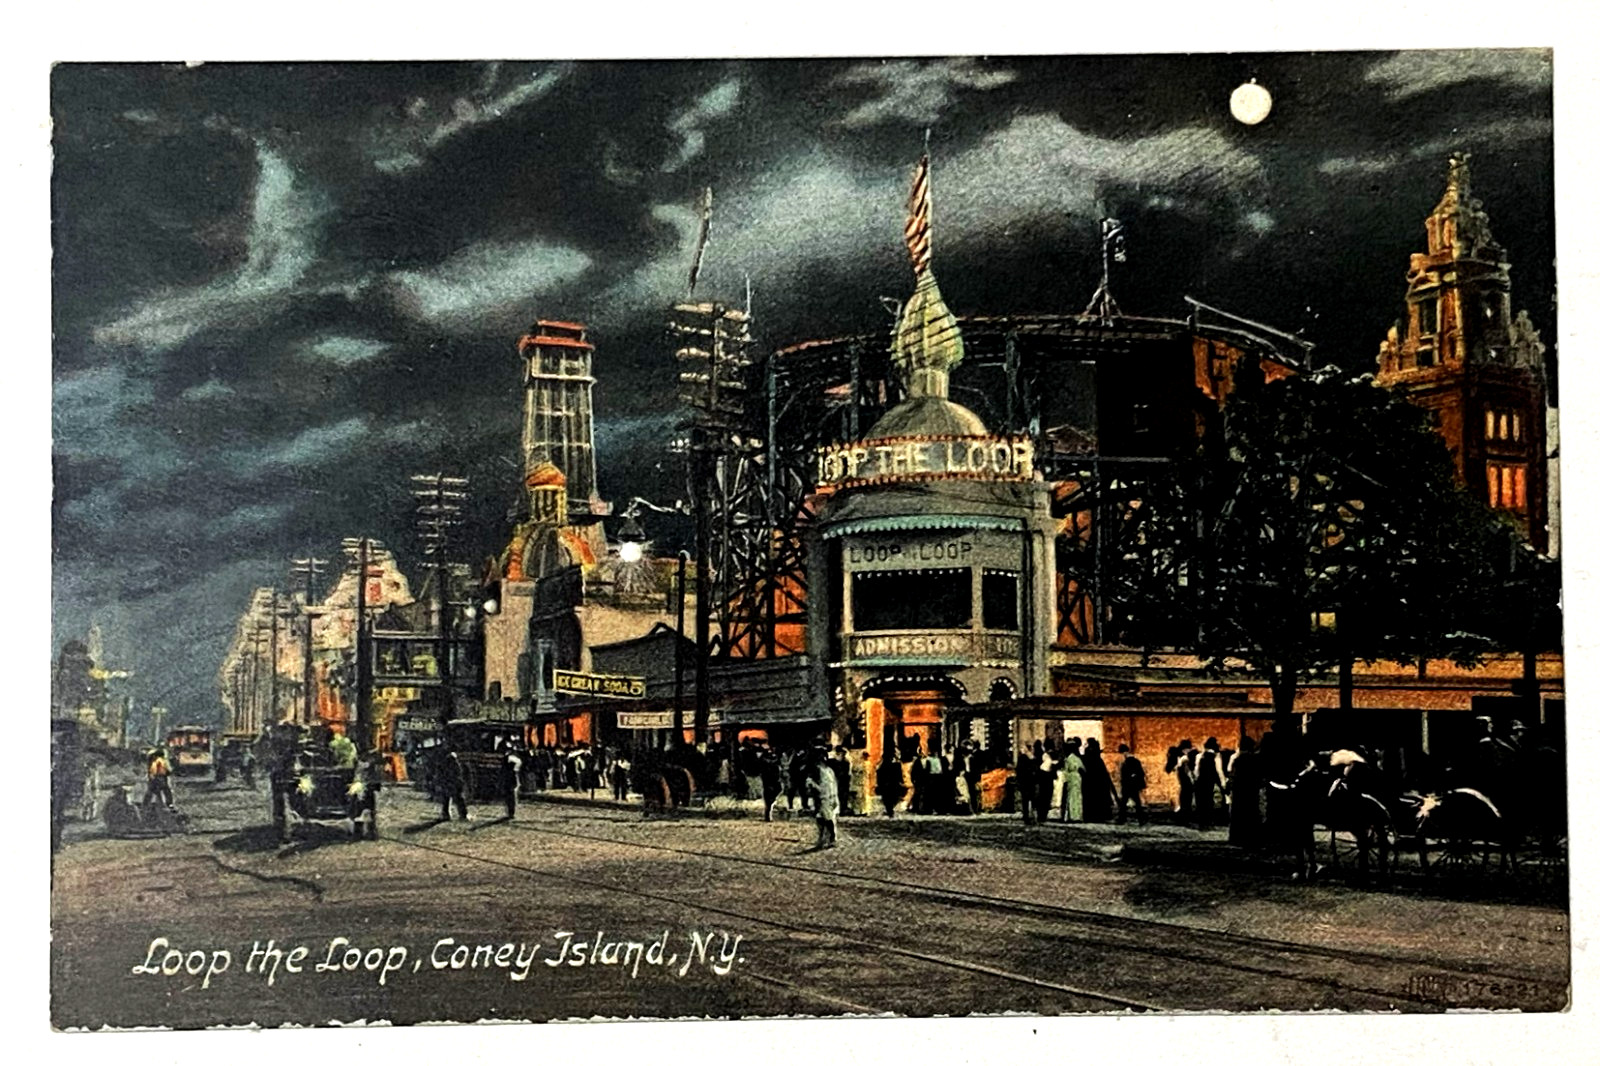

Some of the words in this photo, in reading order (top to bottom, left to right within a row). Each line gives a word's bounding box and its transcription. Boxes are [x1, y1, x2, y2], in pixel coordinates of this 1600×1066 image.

[875, 442, 931, 475] THE
[947, 438, 1034, 479] LOOP
[850, 544, 901, 563] LOOP
[921, 542, 972, 560] LOOP
[132, 937, 231, 989] Loop
[245, 940, 308, 987] the
[316, 936, 421, 986] Loop,
[431, 938, 541, 981] Coney
[545, 930, 678, 979] Island,
[679, 931, 745, 977] N.Y.
